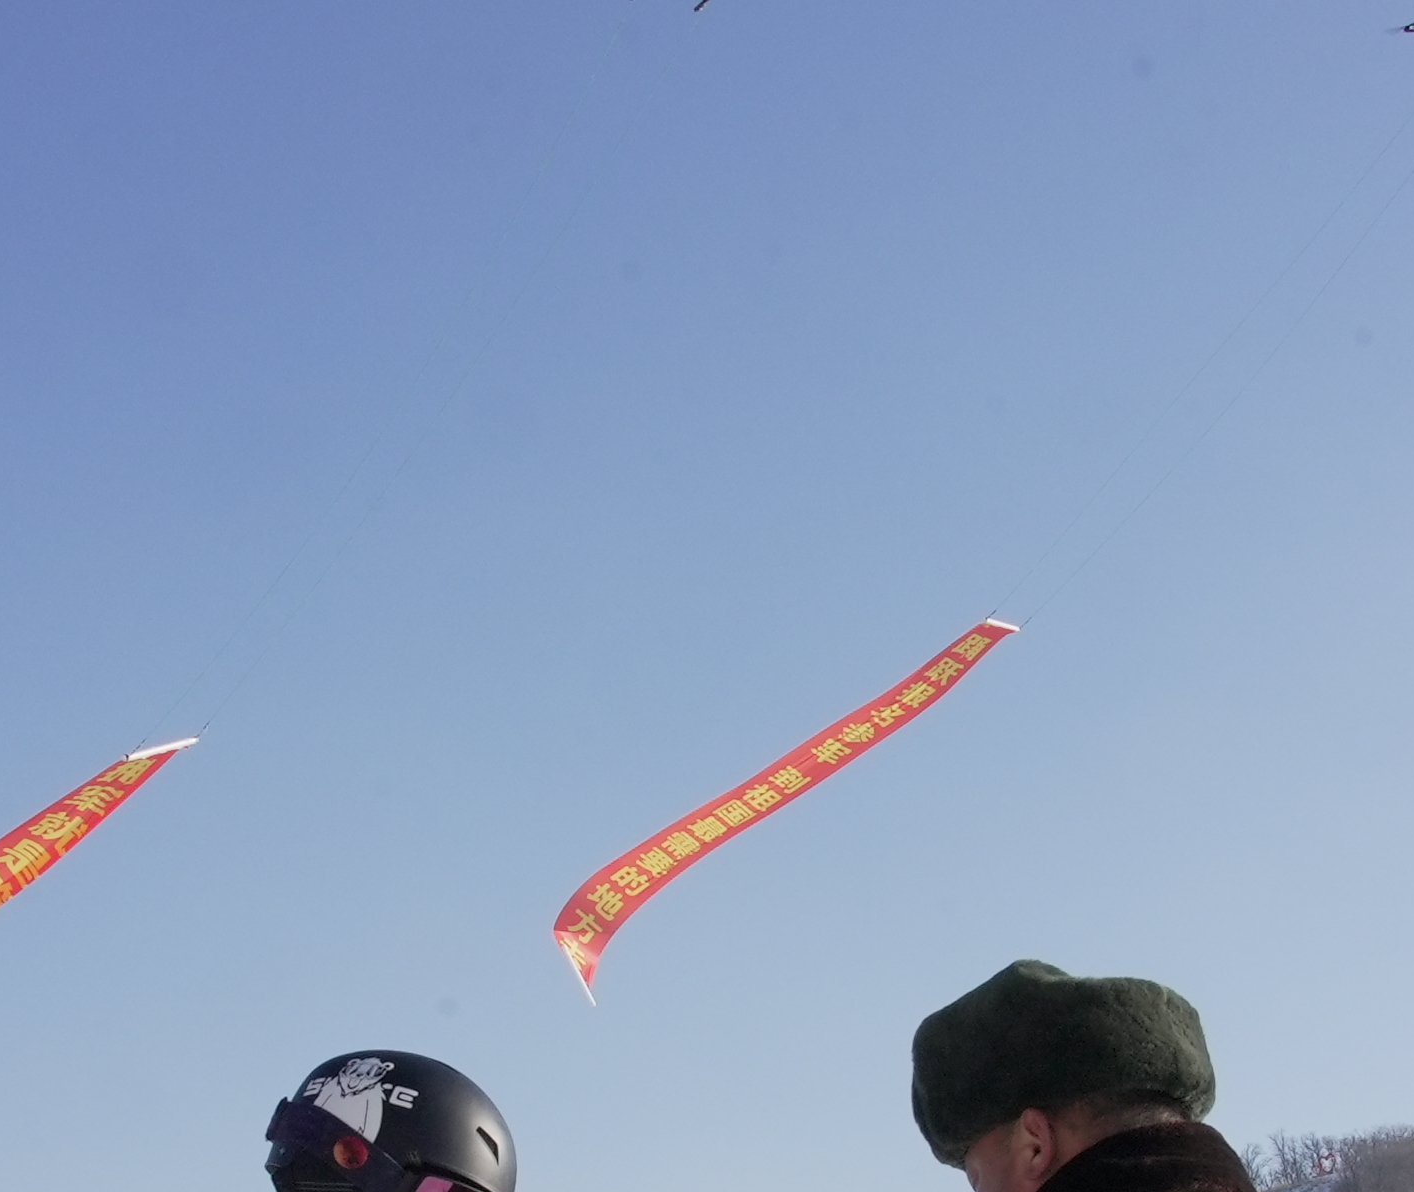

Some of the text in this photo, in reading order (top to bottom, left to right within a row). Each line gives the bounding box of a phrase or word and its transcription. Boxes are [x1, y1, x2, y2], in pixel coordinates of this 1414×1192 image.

[811, 632, 992, 765] 踊跃报名参军
